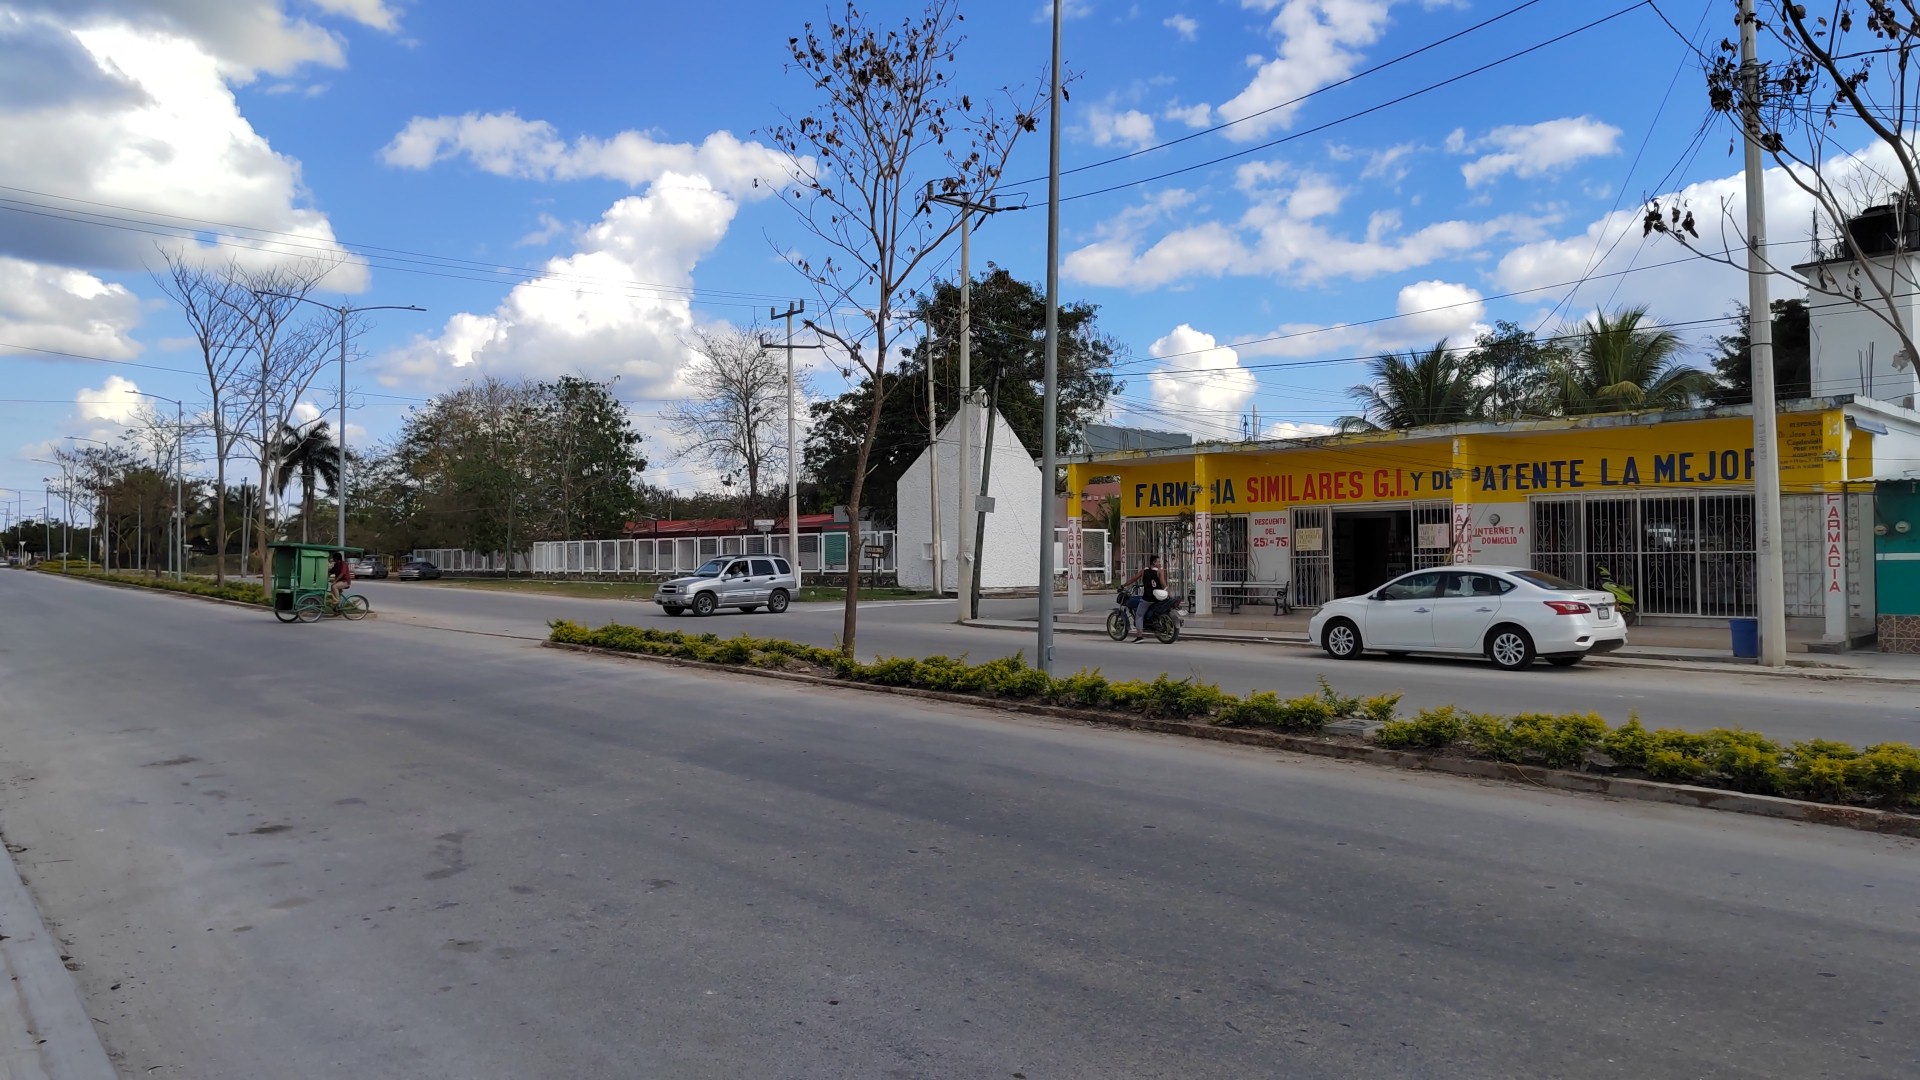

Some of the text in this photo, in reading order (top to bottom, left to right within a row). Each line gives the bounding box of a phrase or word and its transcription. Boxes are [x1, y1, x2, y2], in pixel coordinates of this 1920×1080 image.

[1135, 479, 1236, 507] FARMIA
[1246, 471, 1363, 503] SIMILARES
[1373, 469, 1409, 498] G.I.
[1410, 472, 1424, 492] Y
[1600, 456, 1640, 486] LA
[1254, 517, 1287, 526] DESCUENTO
[1475, 526, 1525, 535] INTERNET A
[1481, 536, 1518, 545] DOMICILIO
[1827, 494, 1841, 592] FARMACIA
